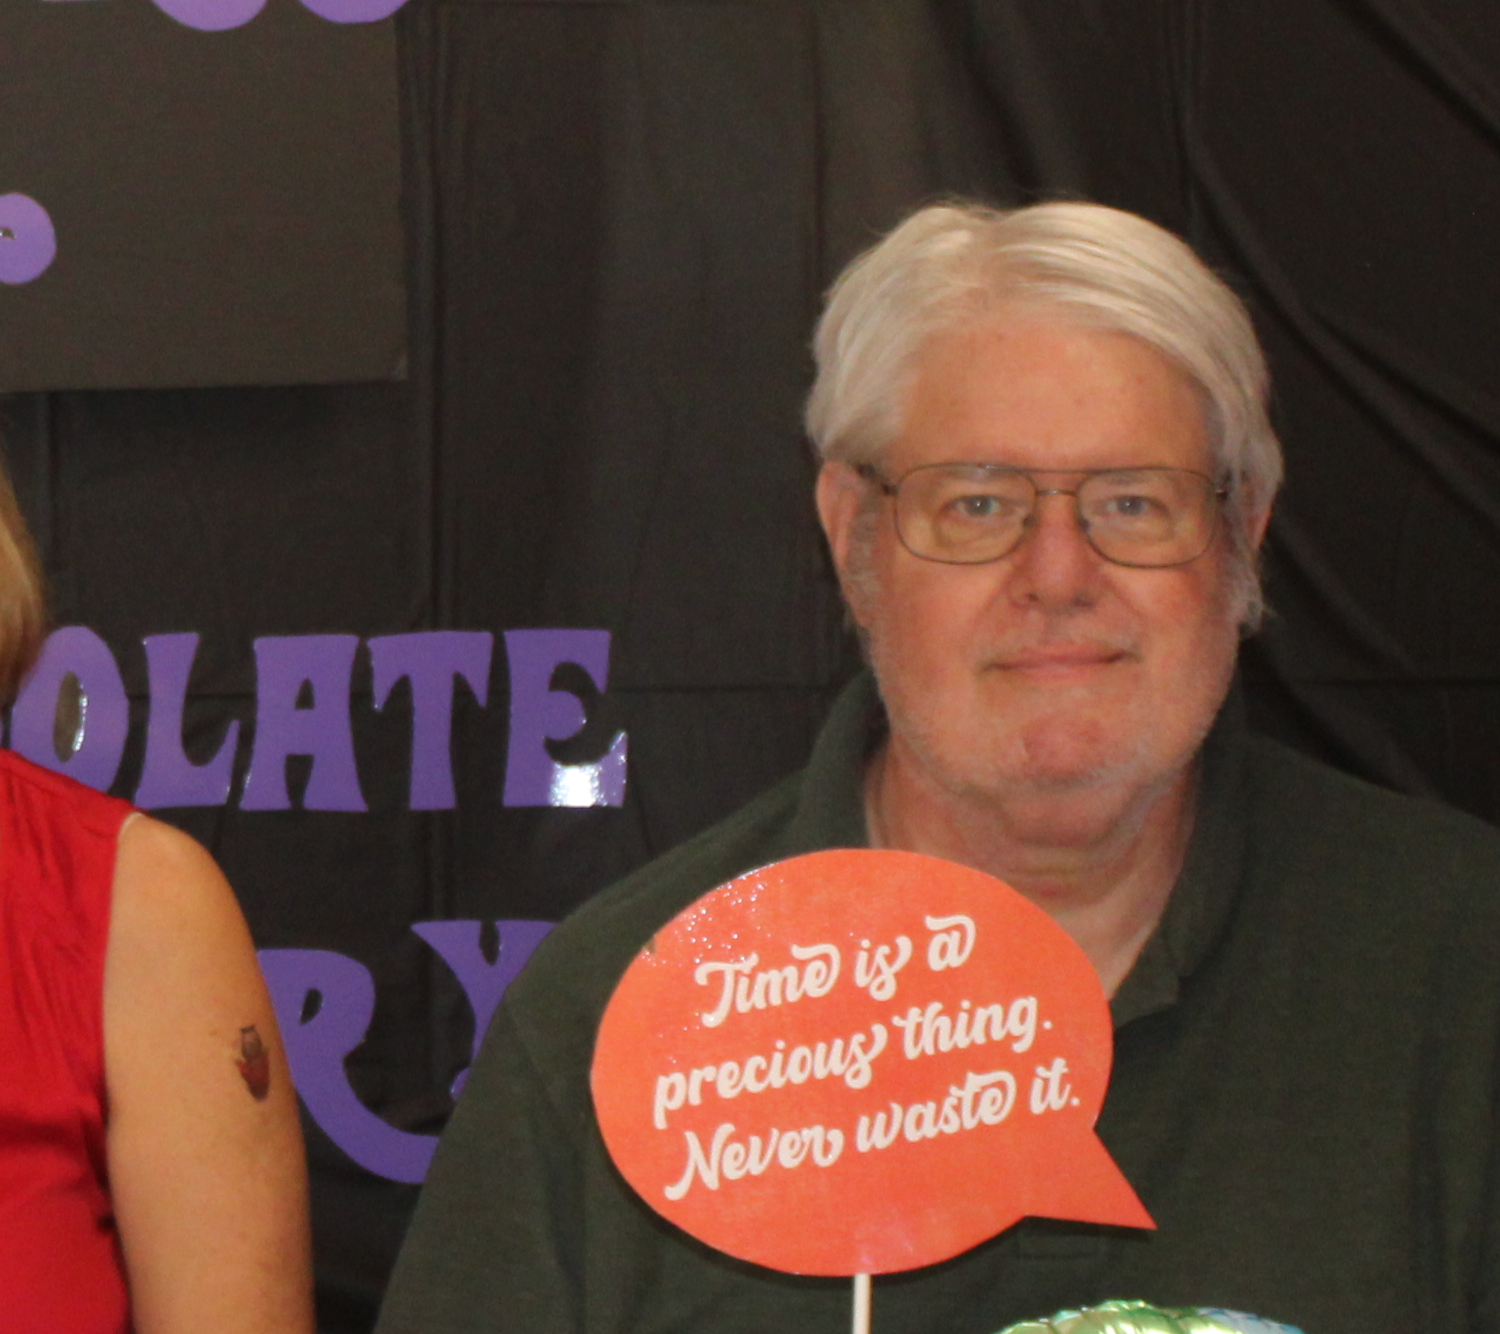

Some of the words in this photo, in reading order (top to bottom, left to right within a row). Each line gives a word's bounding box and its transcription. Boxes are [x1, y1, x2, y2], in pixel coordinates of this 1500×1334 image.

[695, 943, 840, 1028] Time
[854, 935, 911, 1001] is
[925, 913, 976, 972] a
[653, 1024, 887, 1130] precious
[892, 995, 1054, 1055] thing.
[664, 1123, 844, 1201] Never
[855, 1069, 1016, 1153] waste
[1029, 1058, 1081, 1116] it.
